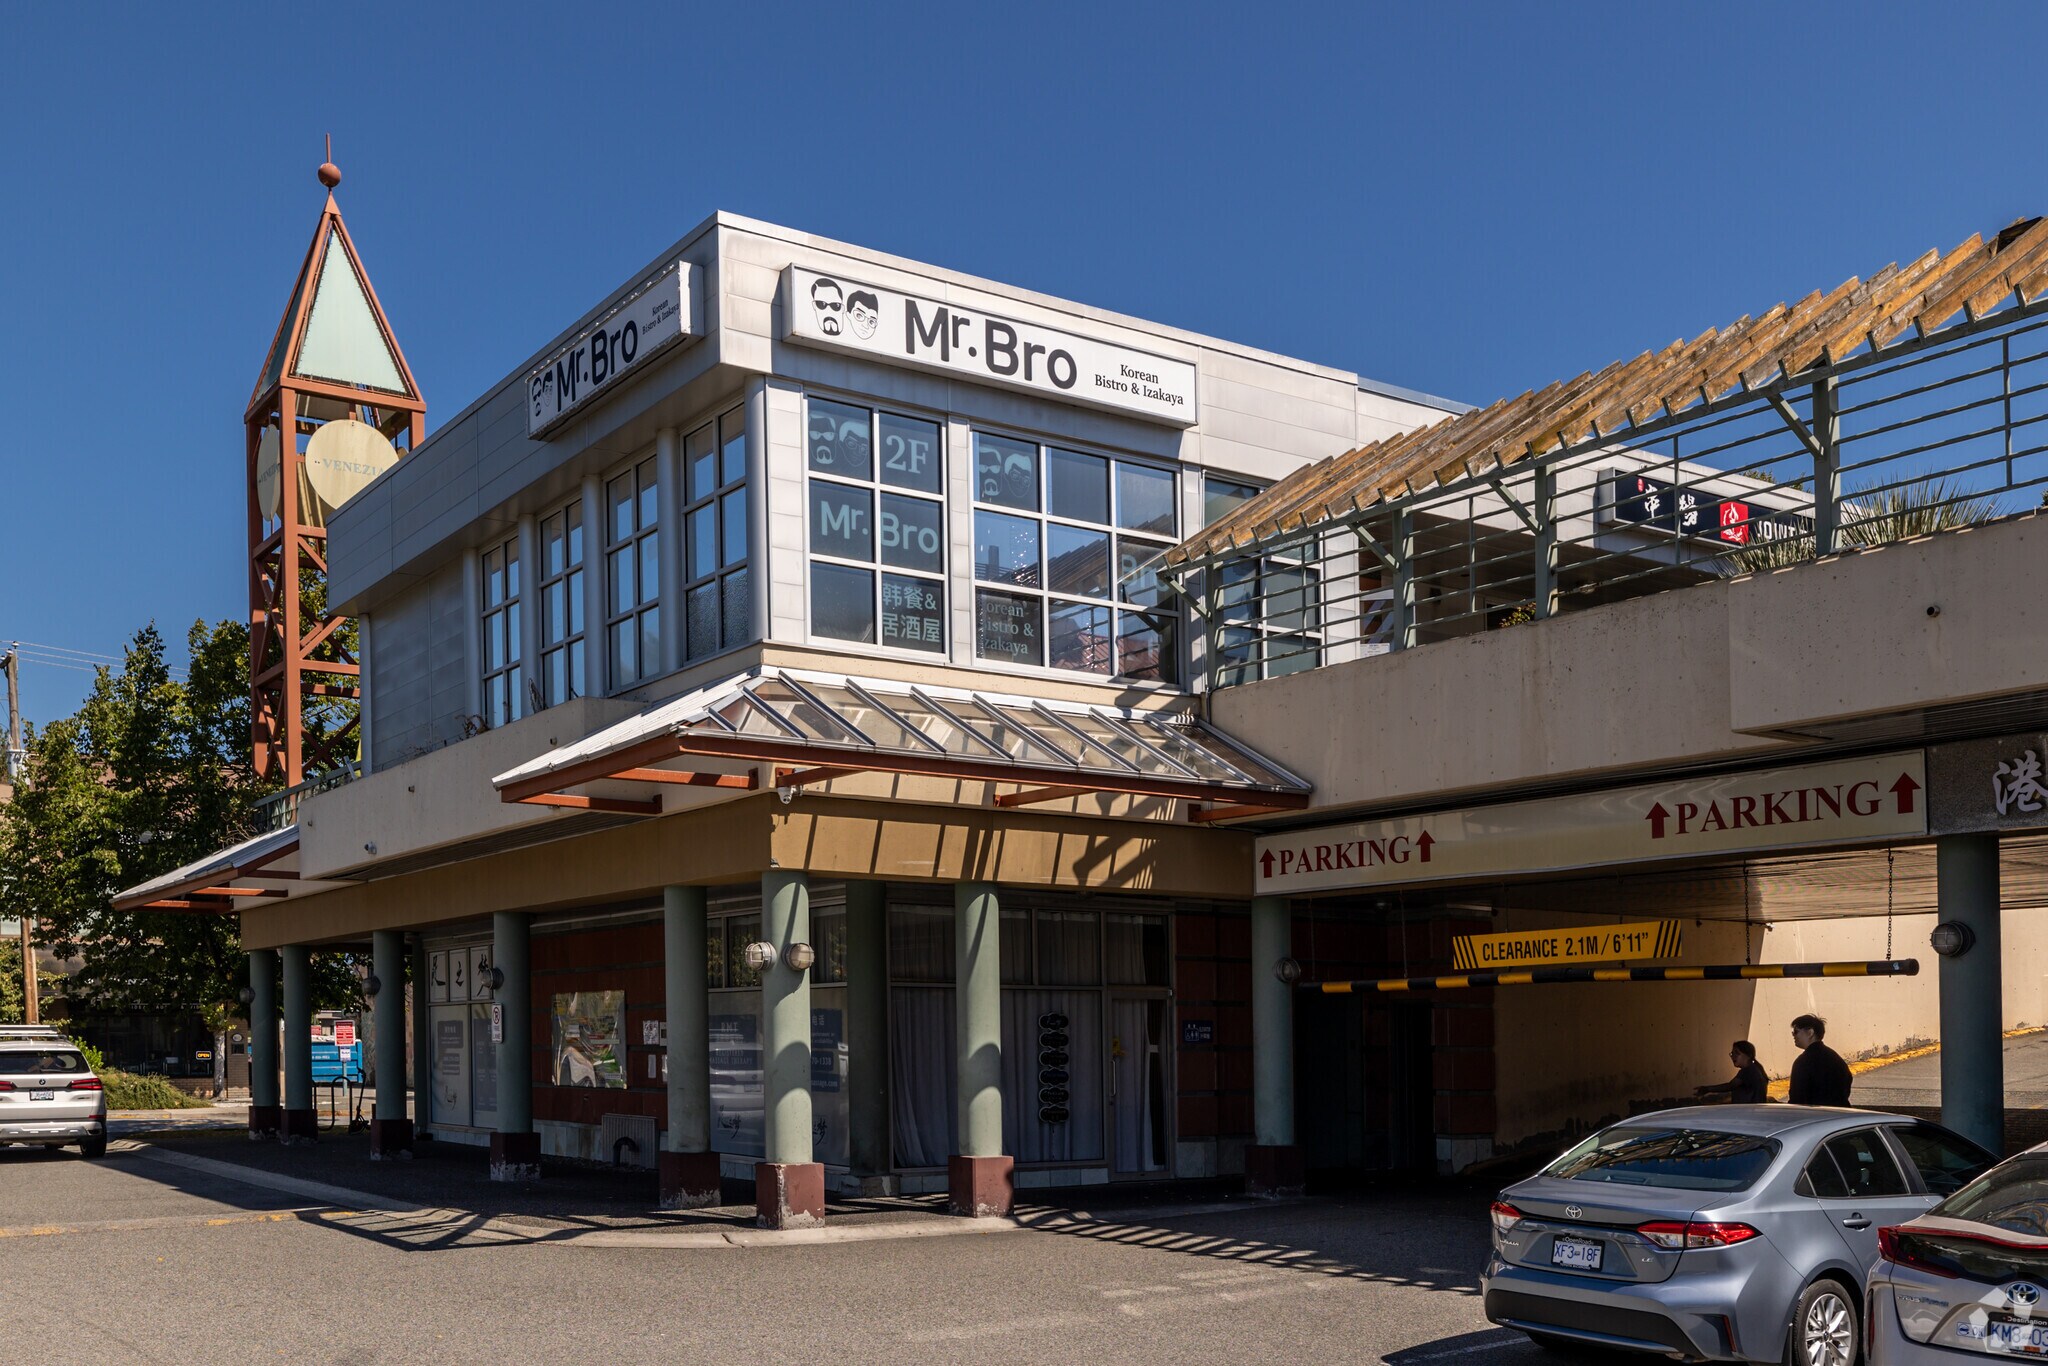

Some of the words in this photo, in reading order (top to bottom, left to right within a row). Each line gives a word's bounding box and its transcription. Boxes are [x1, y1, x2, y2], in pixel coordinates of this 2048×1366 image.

[652, 299, 669, 317] Korean
[642, 319, 657, 335] Bistro
[1120, 364, 1159, 384] Korean
[1094, 374, 1128, 393] Bistro
[1131, 382, 1140, 395] &
[1143, 385, 1184, 405] Izakaya
[886, 434, 929, 474] 2F
[322, 458, 385, 476] VENEZIA
[987, 602, 1024, 618] orean
[882, 612, 940, 643] 居酒屋
[986, 617, 1019, 635] istro
[1023, 623, 1034, 637] &
[984, 637, 1028, 656] zakaya
[1992, 750, 2048, 816] 港
[1674, 779, 1882, 836] PARKING
[1279, 835, 1411, 876] PARKING
[1482, 938, 1559, 962] CLEARANCE
[720, 1022, 738, 1033] RMT
[2007, 1316, 2048, 1326] Destination
